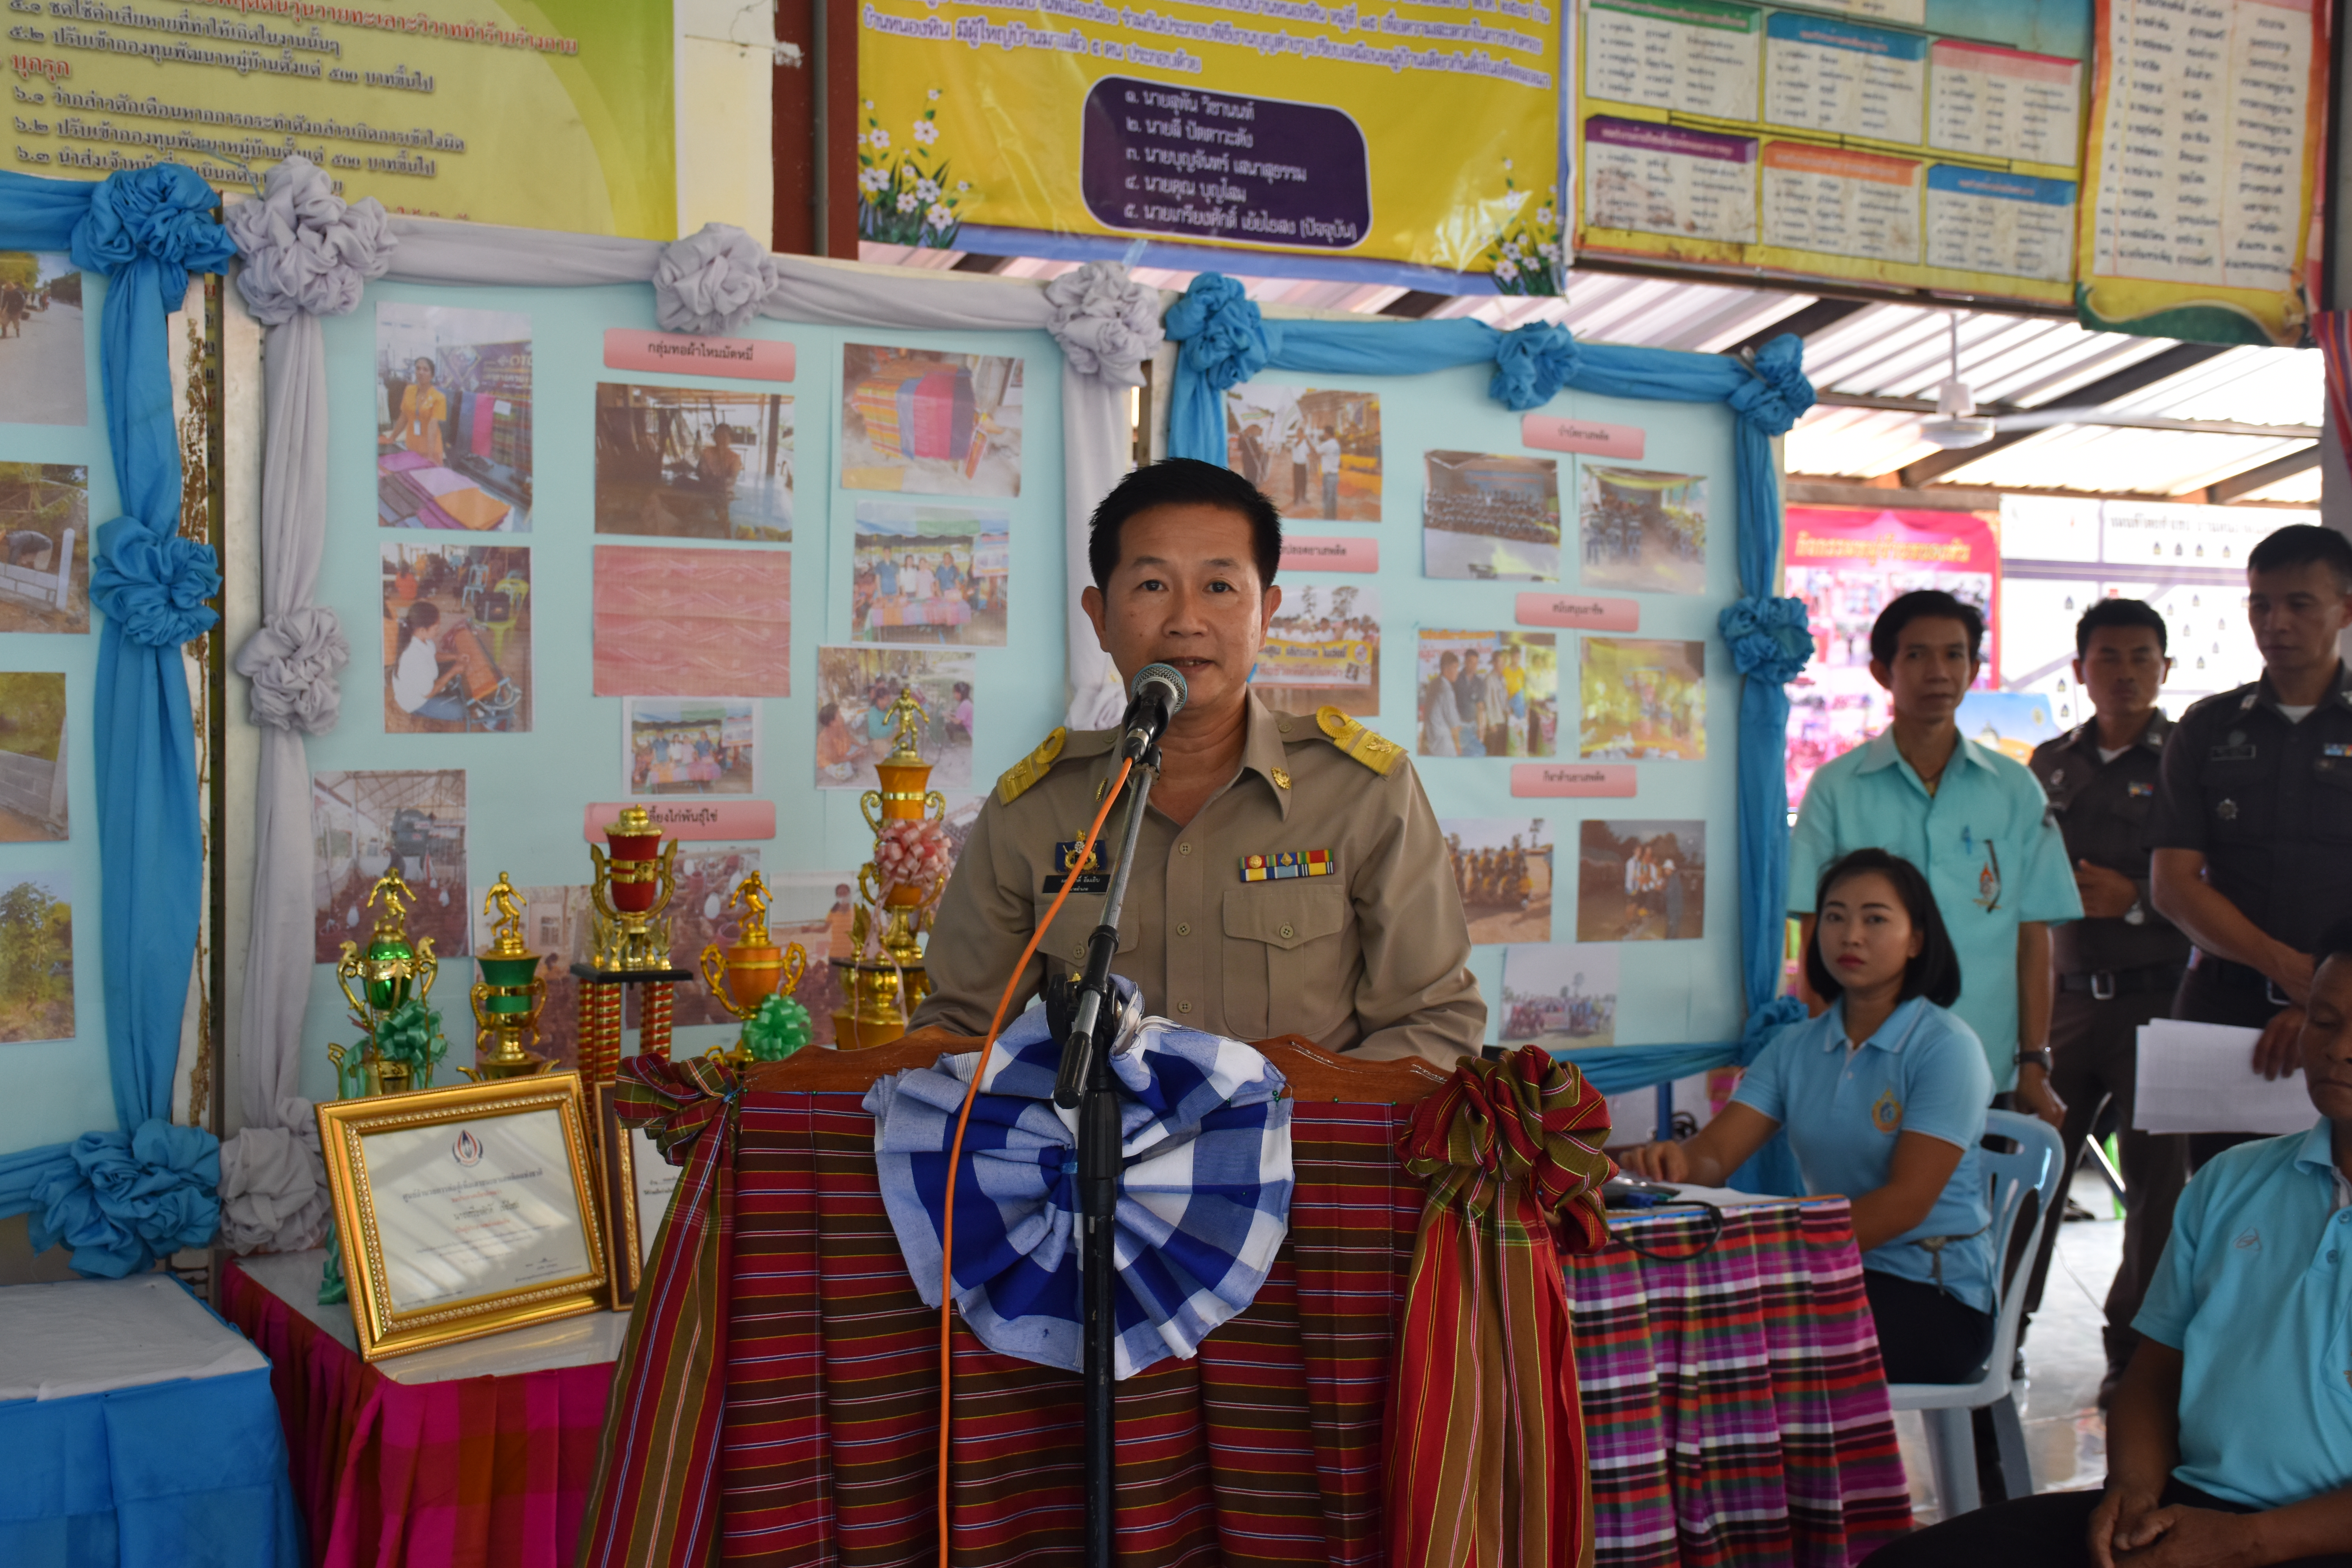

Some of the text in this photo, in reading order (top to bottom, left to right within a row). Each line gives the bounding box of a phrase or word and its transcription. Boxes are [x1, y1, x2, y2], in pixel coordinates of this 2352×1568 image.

[955, 15, 1087, 54] มีผู้ใหญ่บ้านมาแล้ว
[1103, 40, 1124, 61] คน
[1125, 42, 1202, 74] ประกอบด้วย
[12, 54, 70, 82] บุกรุก
[53, 26, 322, 76] ปรับเข้ากองทุนพัฒนาหมู่บ้านตั้งแต่
[364, 64, 434, 92] บาทขึ้นไป
[367, 149, 436, 177] บาทขึ้นไป
[1299, 215, 1357, 245] (ปัจจุบัน)
[648, 341, 754, 361] กลุ่มทอผ้าไหมมัดหมี่
[648, 806, 718, 826] ลี้ยงไก่พันธุ์ไข่
